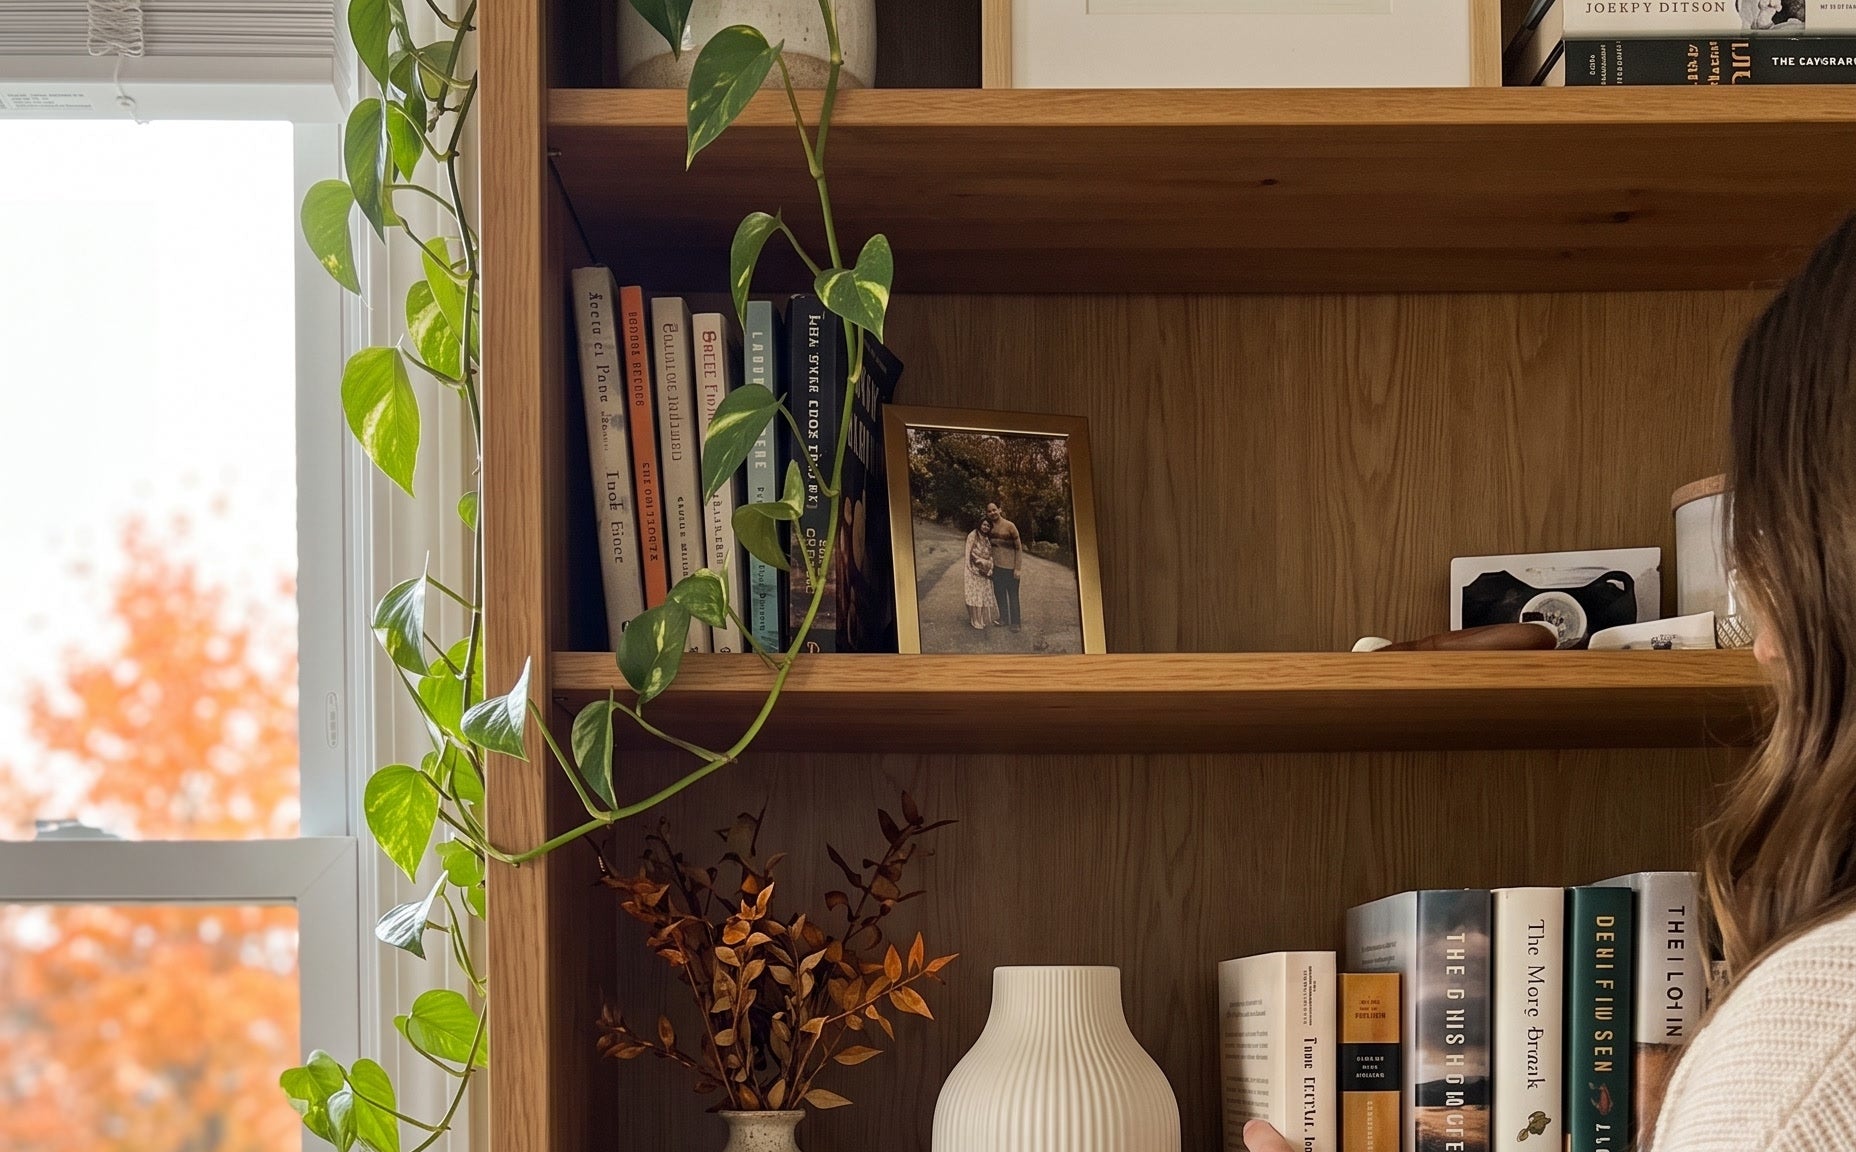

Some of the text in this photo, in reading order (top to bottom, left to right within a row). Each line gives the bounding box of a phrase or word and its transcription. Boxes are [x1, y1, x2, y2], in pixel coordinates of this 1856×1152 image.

[1585, 1, 1726, 13] JOEKPY DITSON
[1772, 57, 1796, 66] THE
[1528, 919, 1545, 956] The
[1446, 933, 1464, 975] THE
